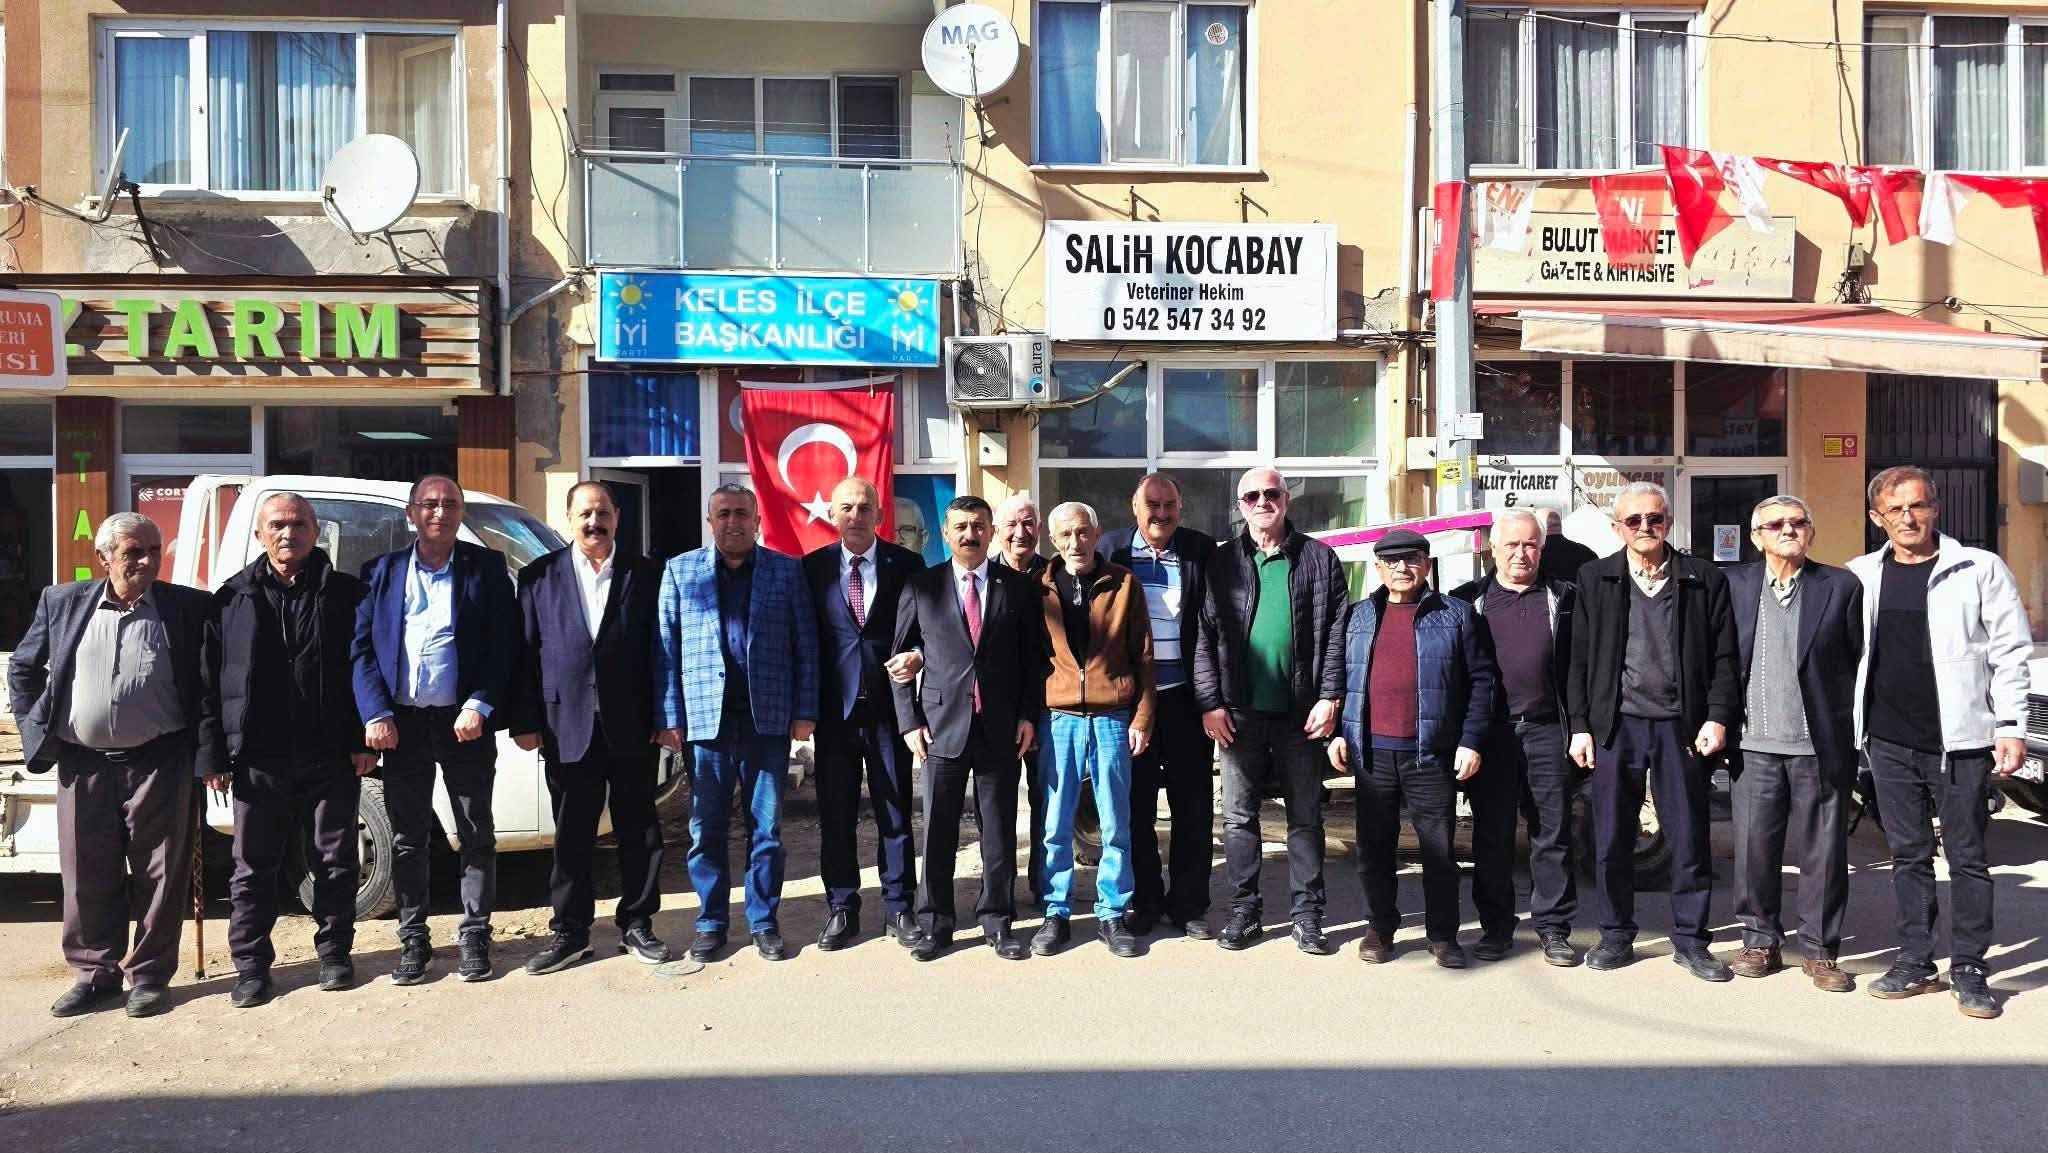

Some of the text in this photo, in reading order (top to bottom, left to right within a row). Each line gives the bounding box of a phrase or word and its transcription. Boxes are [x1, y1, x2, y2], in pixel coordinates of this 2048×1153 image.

[941, 21, 999, 45] MAG
[1542, 226, 1676, 254] BULUT MARKET
[1166, 234, 1304, 275] KOCABAY
[1593, 262, 1603, 281] &
[675, 287, 866, 321] KELES İLÇE
[1127, 282, 1244, 301] Veteriner Hekim
[113, 299, 397, 359] TARIM
[1103, 306, 1266, 332] 0 542 547 34 92
[675, 319, 865, 352] BAŞKANLIĞI
[1032, 342, 1042, 374] aura
[1504, 492, 1518, 507] &
